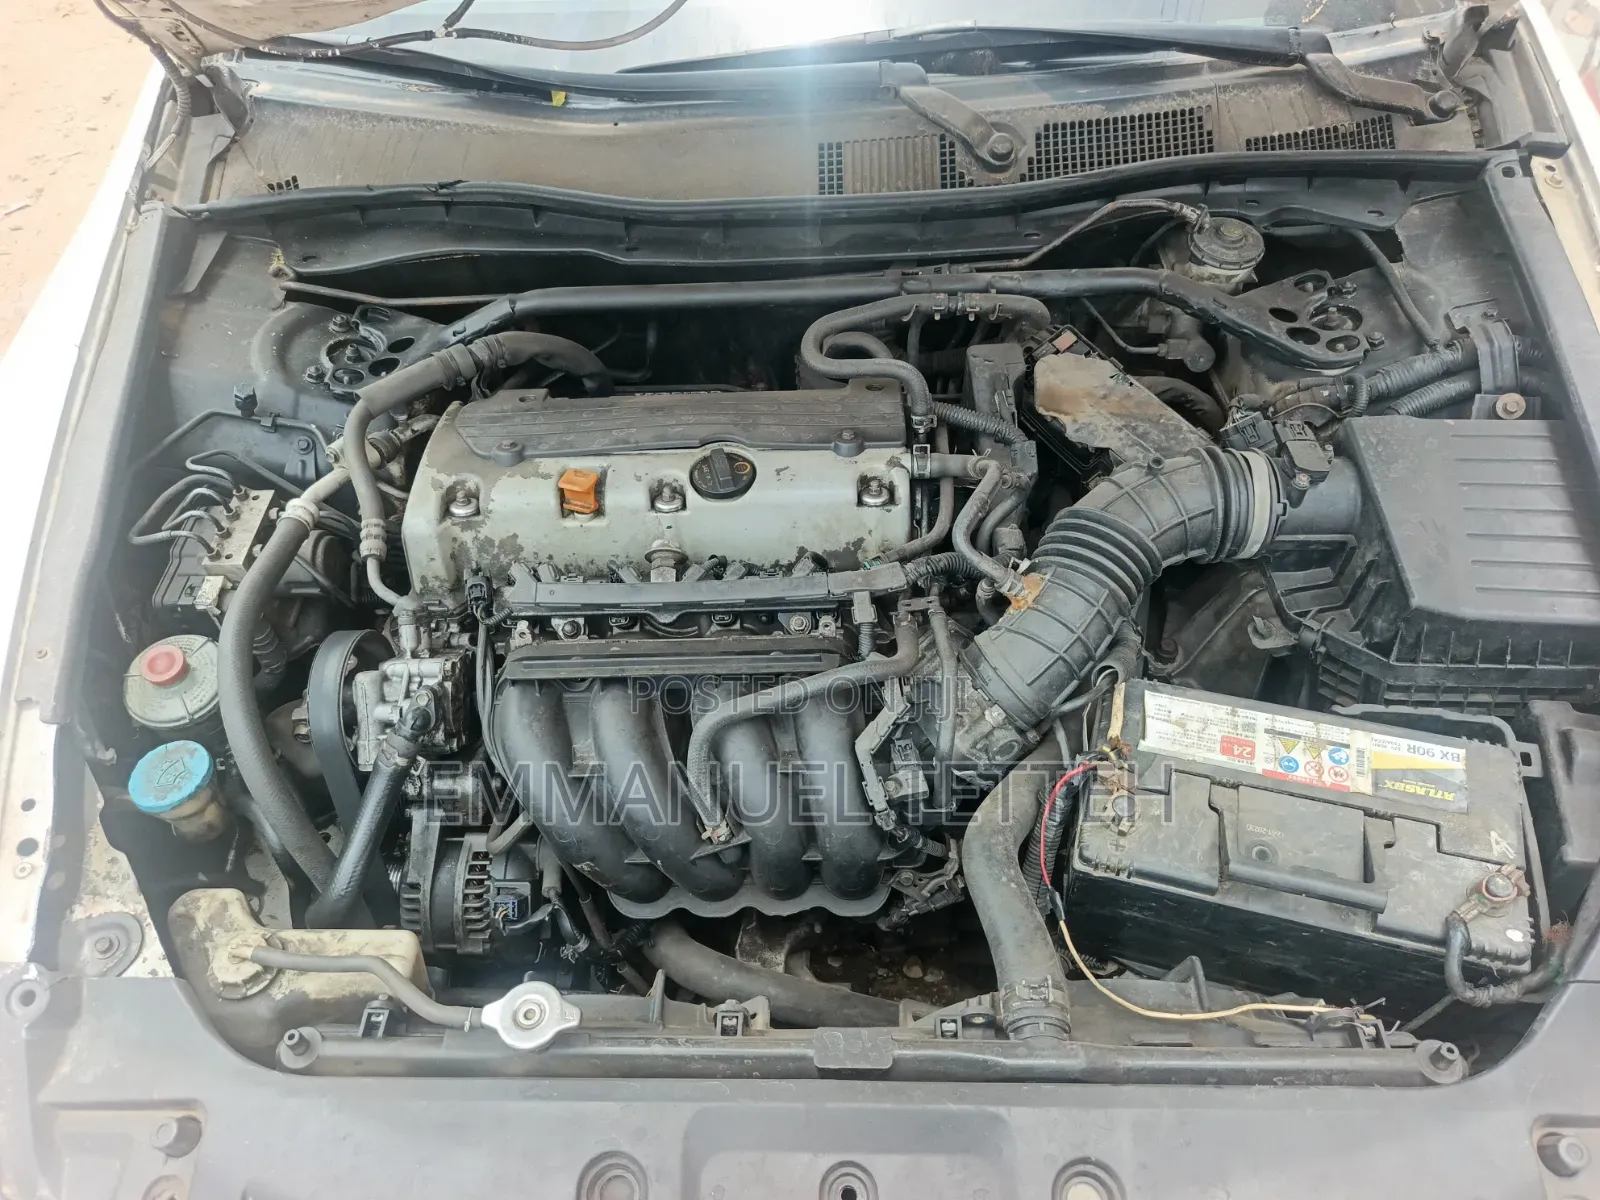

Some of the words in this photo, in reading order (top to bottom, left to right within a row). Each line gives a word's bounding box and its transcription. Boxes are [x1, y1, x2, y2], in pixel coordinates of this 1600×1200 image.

[1232, 744, 1253, 758] 24
[1406, 743, 1436, 757] 90R
[1440, 750, 1461, 762] BX
[1383, 780, 1456, 801] ATLASBX
